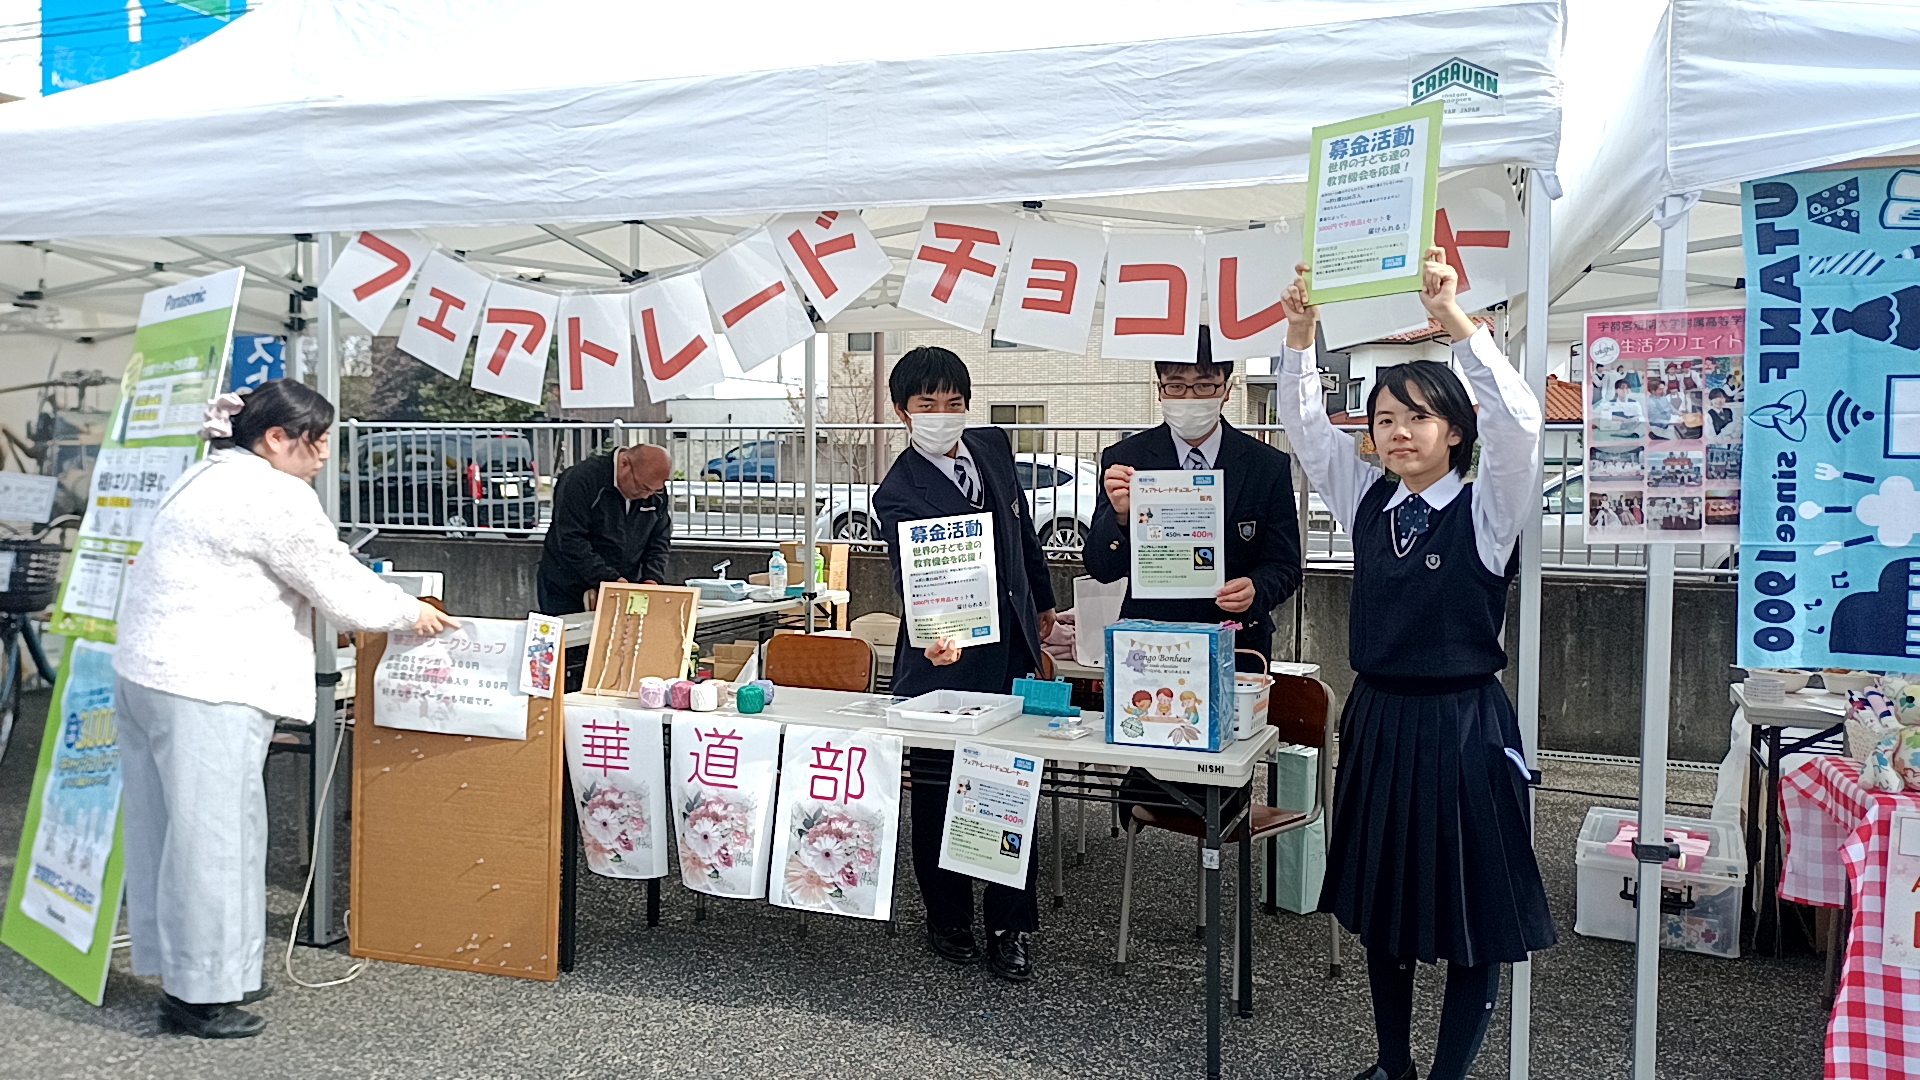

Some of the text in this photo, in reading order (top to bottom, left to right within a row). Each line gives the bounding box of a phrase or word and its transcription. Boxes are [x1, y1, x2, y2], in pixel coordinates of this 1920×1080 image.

[1413, 63, 1498, 99] CARAVAN
[1329, 125, 1415, 160] 募金活動
[1328, 148, 1410, 174] 世界の子ども達の
[164, 286, 207, 312] Panasonic
[1620, 334, 1742, 354] 生活クリエイト
[1139, 486, 1202, 494] フェアトレードチョコレート
[910, 519, 983, 544] 募金活動
[912, 540, 982, 557] 世界の子ども達の
[1133, 652, 1191, 664] Congo Bonheur
[478, 680, 509, 690] 500円
[582, 719, 865, 805] 華道部
[963, 758, 1021, 776] フェアトレードチョコレート
[1198, 764, 1224, 774] NISHI
[1017, 779, 1030, 788] 販売
[1003, 813, 1024, 825] 400円
